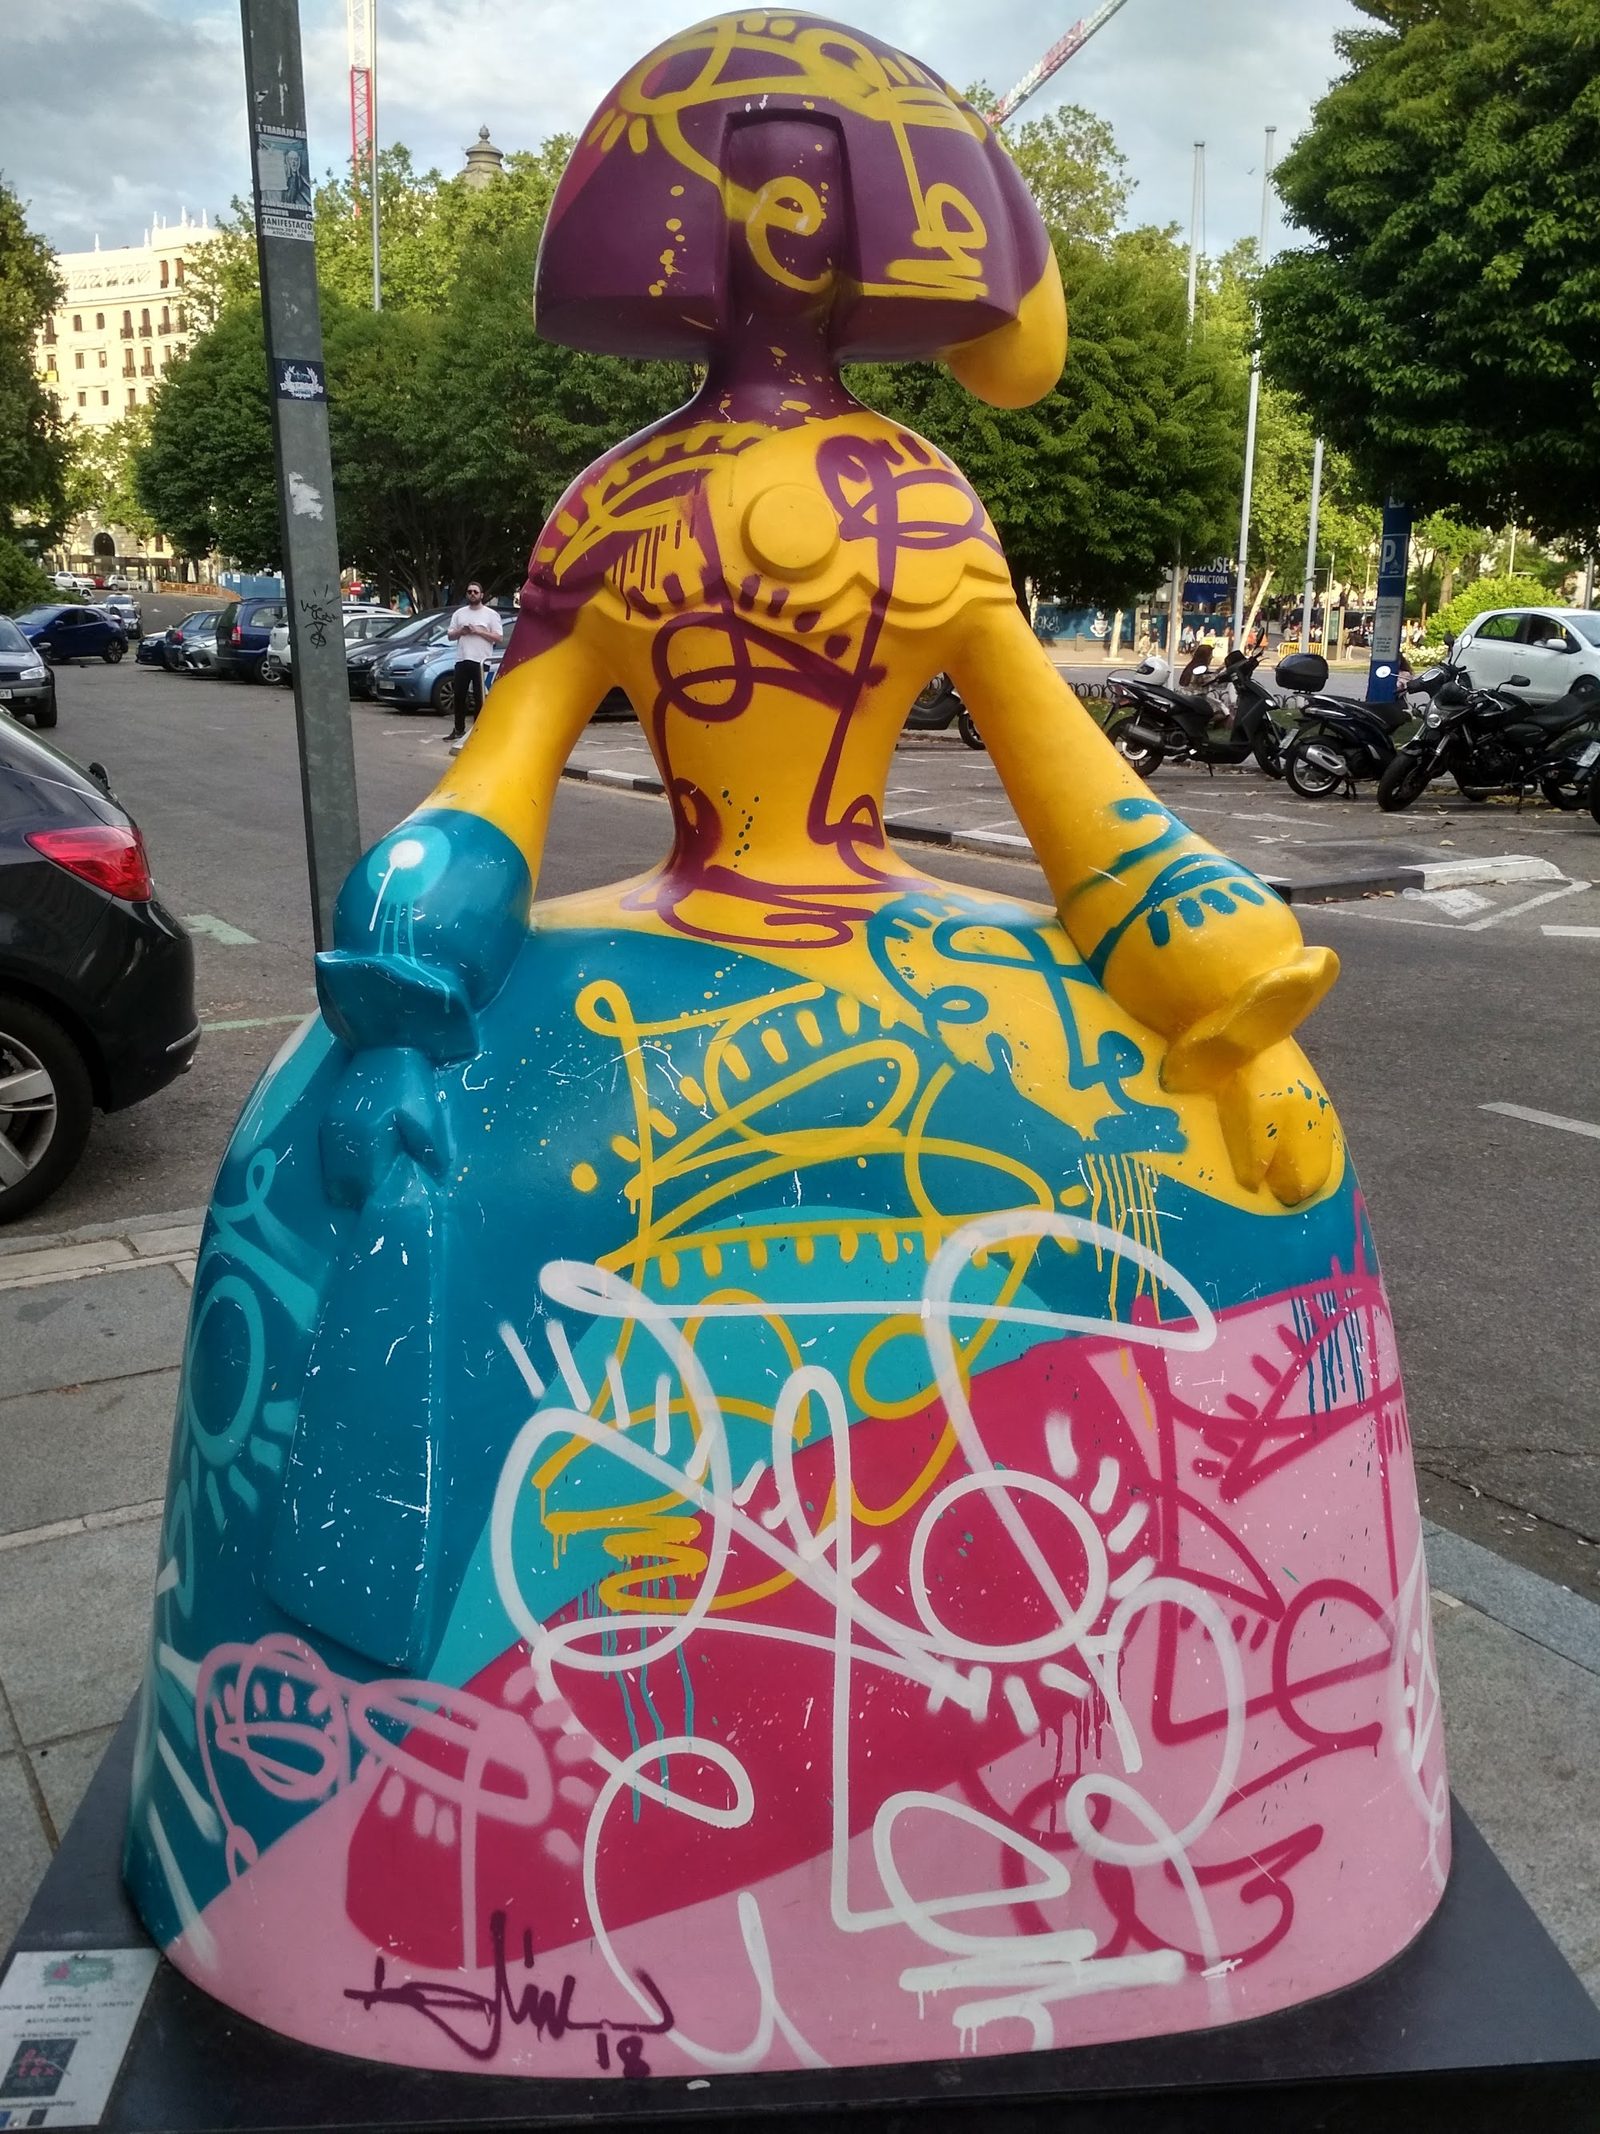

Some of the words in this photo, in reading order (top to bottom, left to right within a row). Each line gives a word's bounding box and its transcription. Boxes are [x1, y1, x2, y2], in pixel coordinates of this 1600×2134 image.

[262, 125, 294, 137] TRABAJO
[1381, 539, 1396, 573] P
[1184, 574, 1228, 585] ONSTRUCTORA
